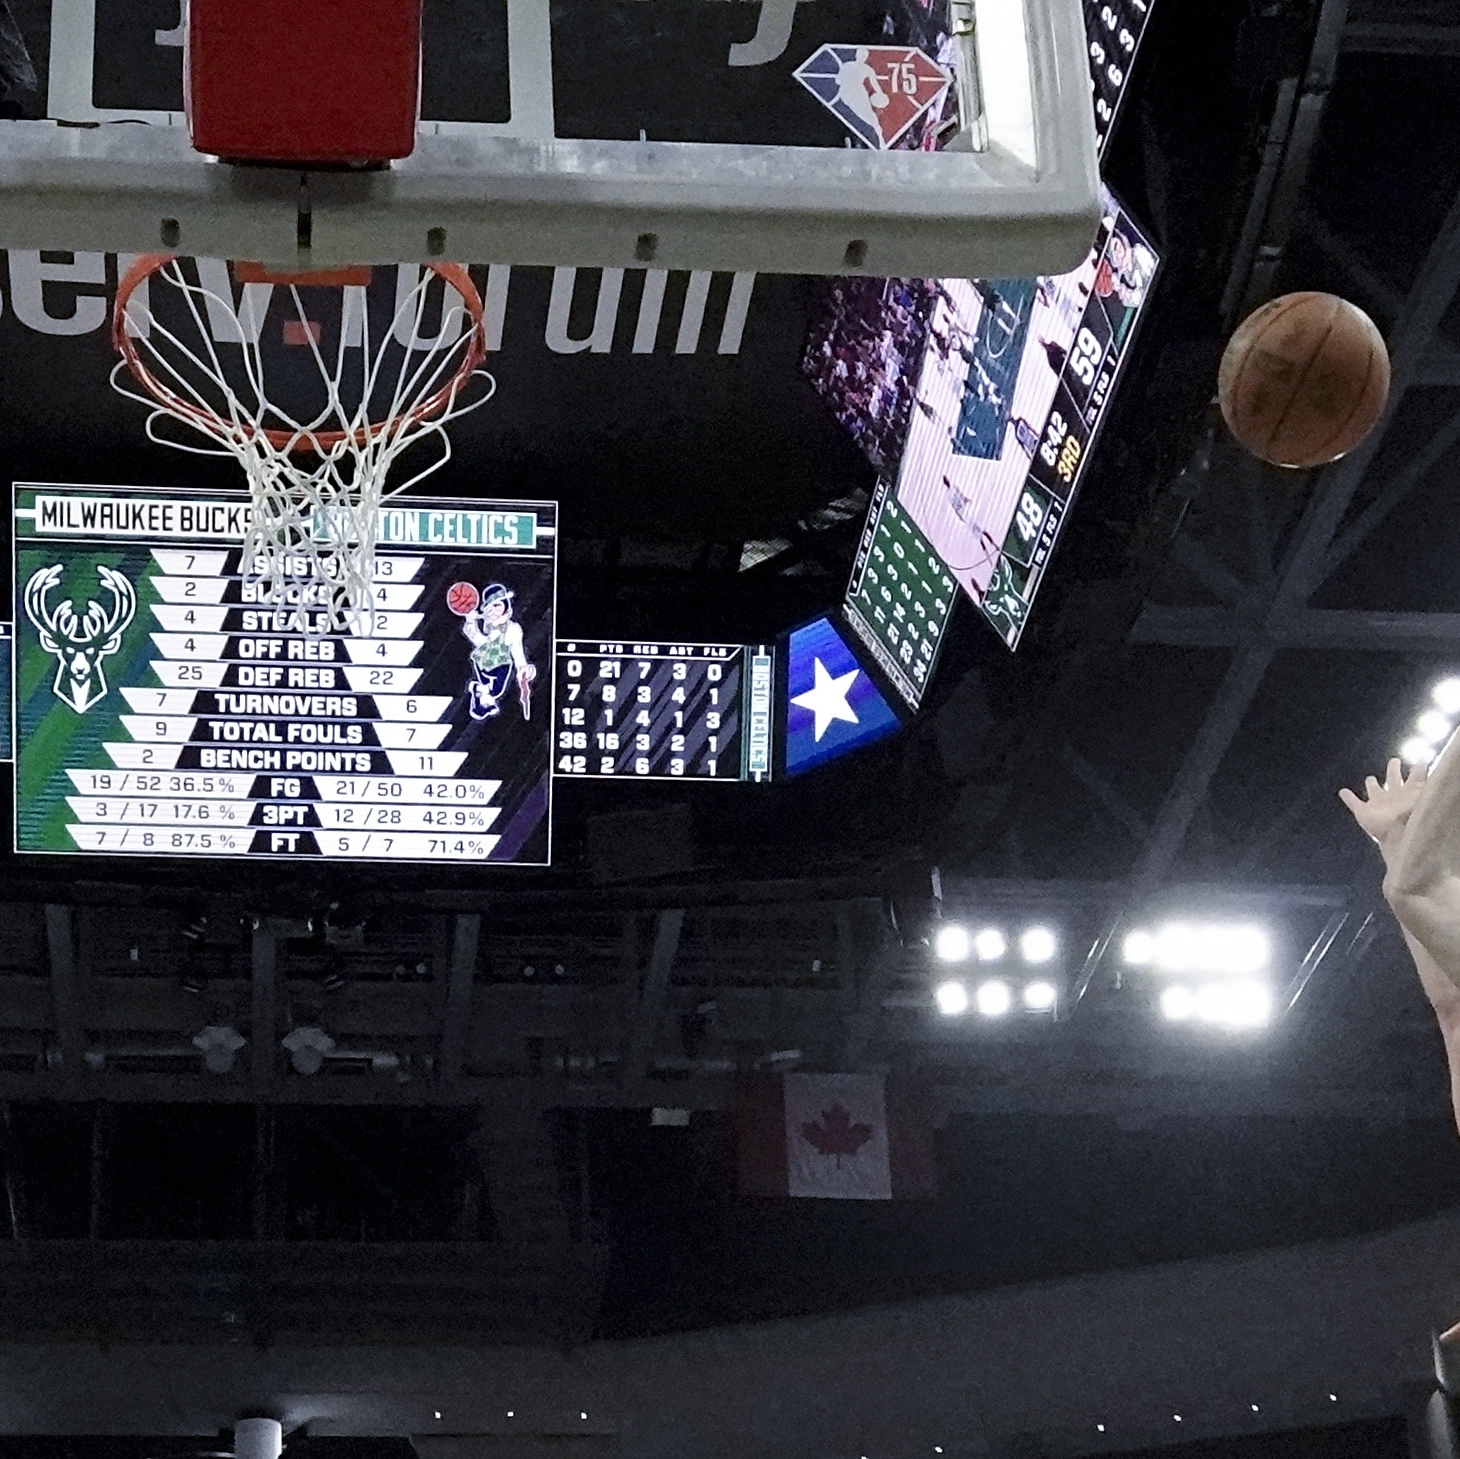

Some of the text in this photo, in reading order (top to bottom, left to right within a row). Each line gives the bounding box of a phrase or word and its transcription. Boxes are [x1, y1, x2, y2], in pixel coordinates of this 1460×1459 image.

[887, 63, 917, 94] 75
[1070, 326, 1102, 386] 59
[1041, 410, 1068, 467] 8:42
[1057, 435, 1082, 483] 3RD
[42, 501, 173, 531] MILWAUKEE
[1016, 491, 1043, 542] 48
[428, 513, 519, 545] CELTICS
[184, 555, 196, 570] 7
[374, 561, 393, 576] 13
[184, 582, 196, 597] 2
[376, 588, 388, 602] 4
[184, 610, 388, 632] 4 STEALS 2
[184, 638, 388, 660] 4 OFF REB 4
[178, 665, 394, 688] 25 DEF REB 22
[156, 692, 417, 717] 7 TURNOVERS 6
[155, 721, 417, 744] 9 TOTAL FOULS 7
[559, 732, 717, 752] 36 16 3 2 1
[142, 748, 433, 772] 2 BENCH POINTS 11
[92, 774, 111, 789] 19
[136, 776, 161, 791] 52
[270, 778, 301, 797] FG
[336, 780, 485, 799] 21 50 42.0%
[95, 803, 108, 817] 3
[139, 803, 158, 818] 17
[262, 805, 308, 825] 3PT
[334, 808, 485, 826] 12 28 42.9%
[95, 831, 107, 845] 7
[142, 832, 154, 847] 8
[270, 832, 300, 852] FT
[338, 837, 484, 855] 5 7 71.4%
